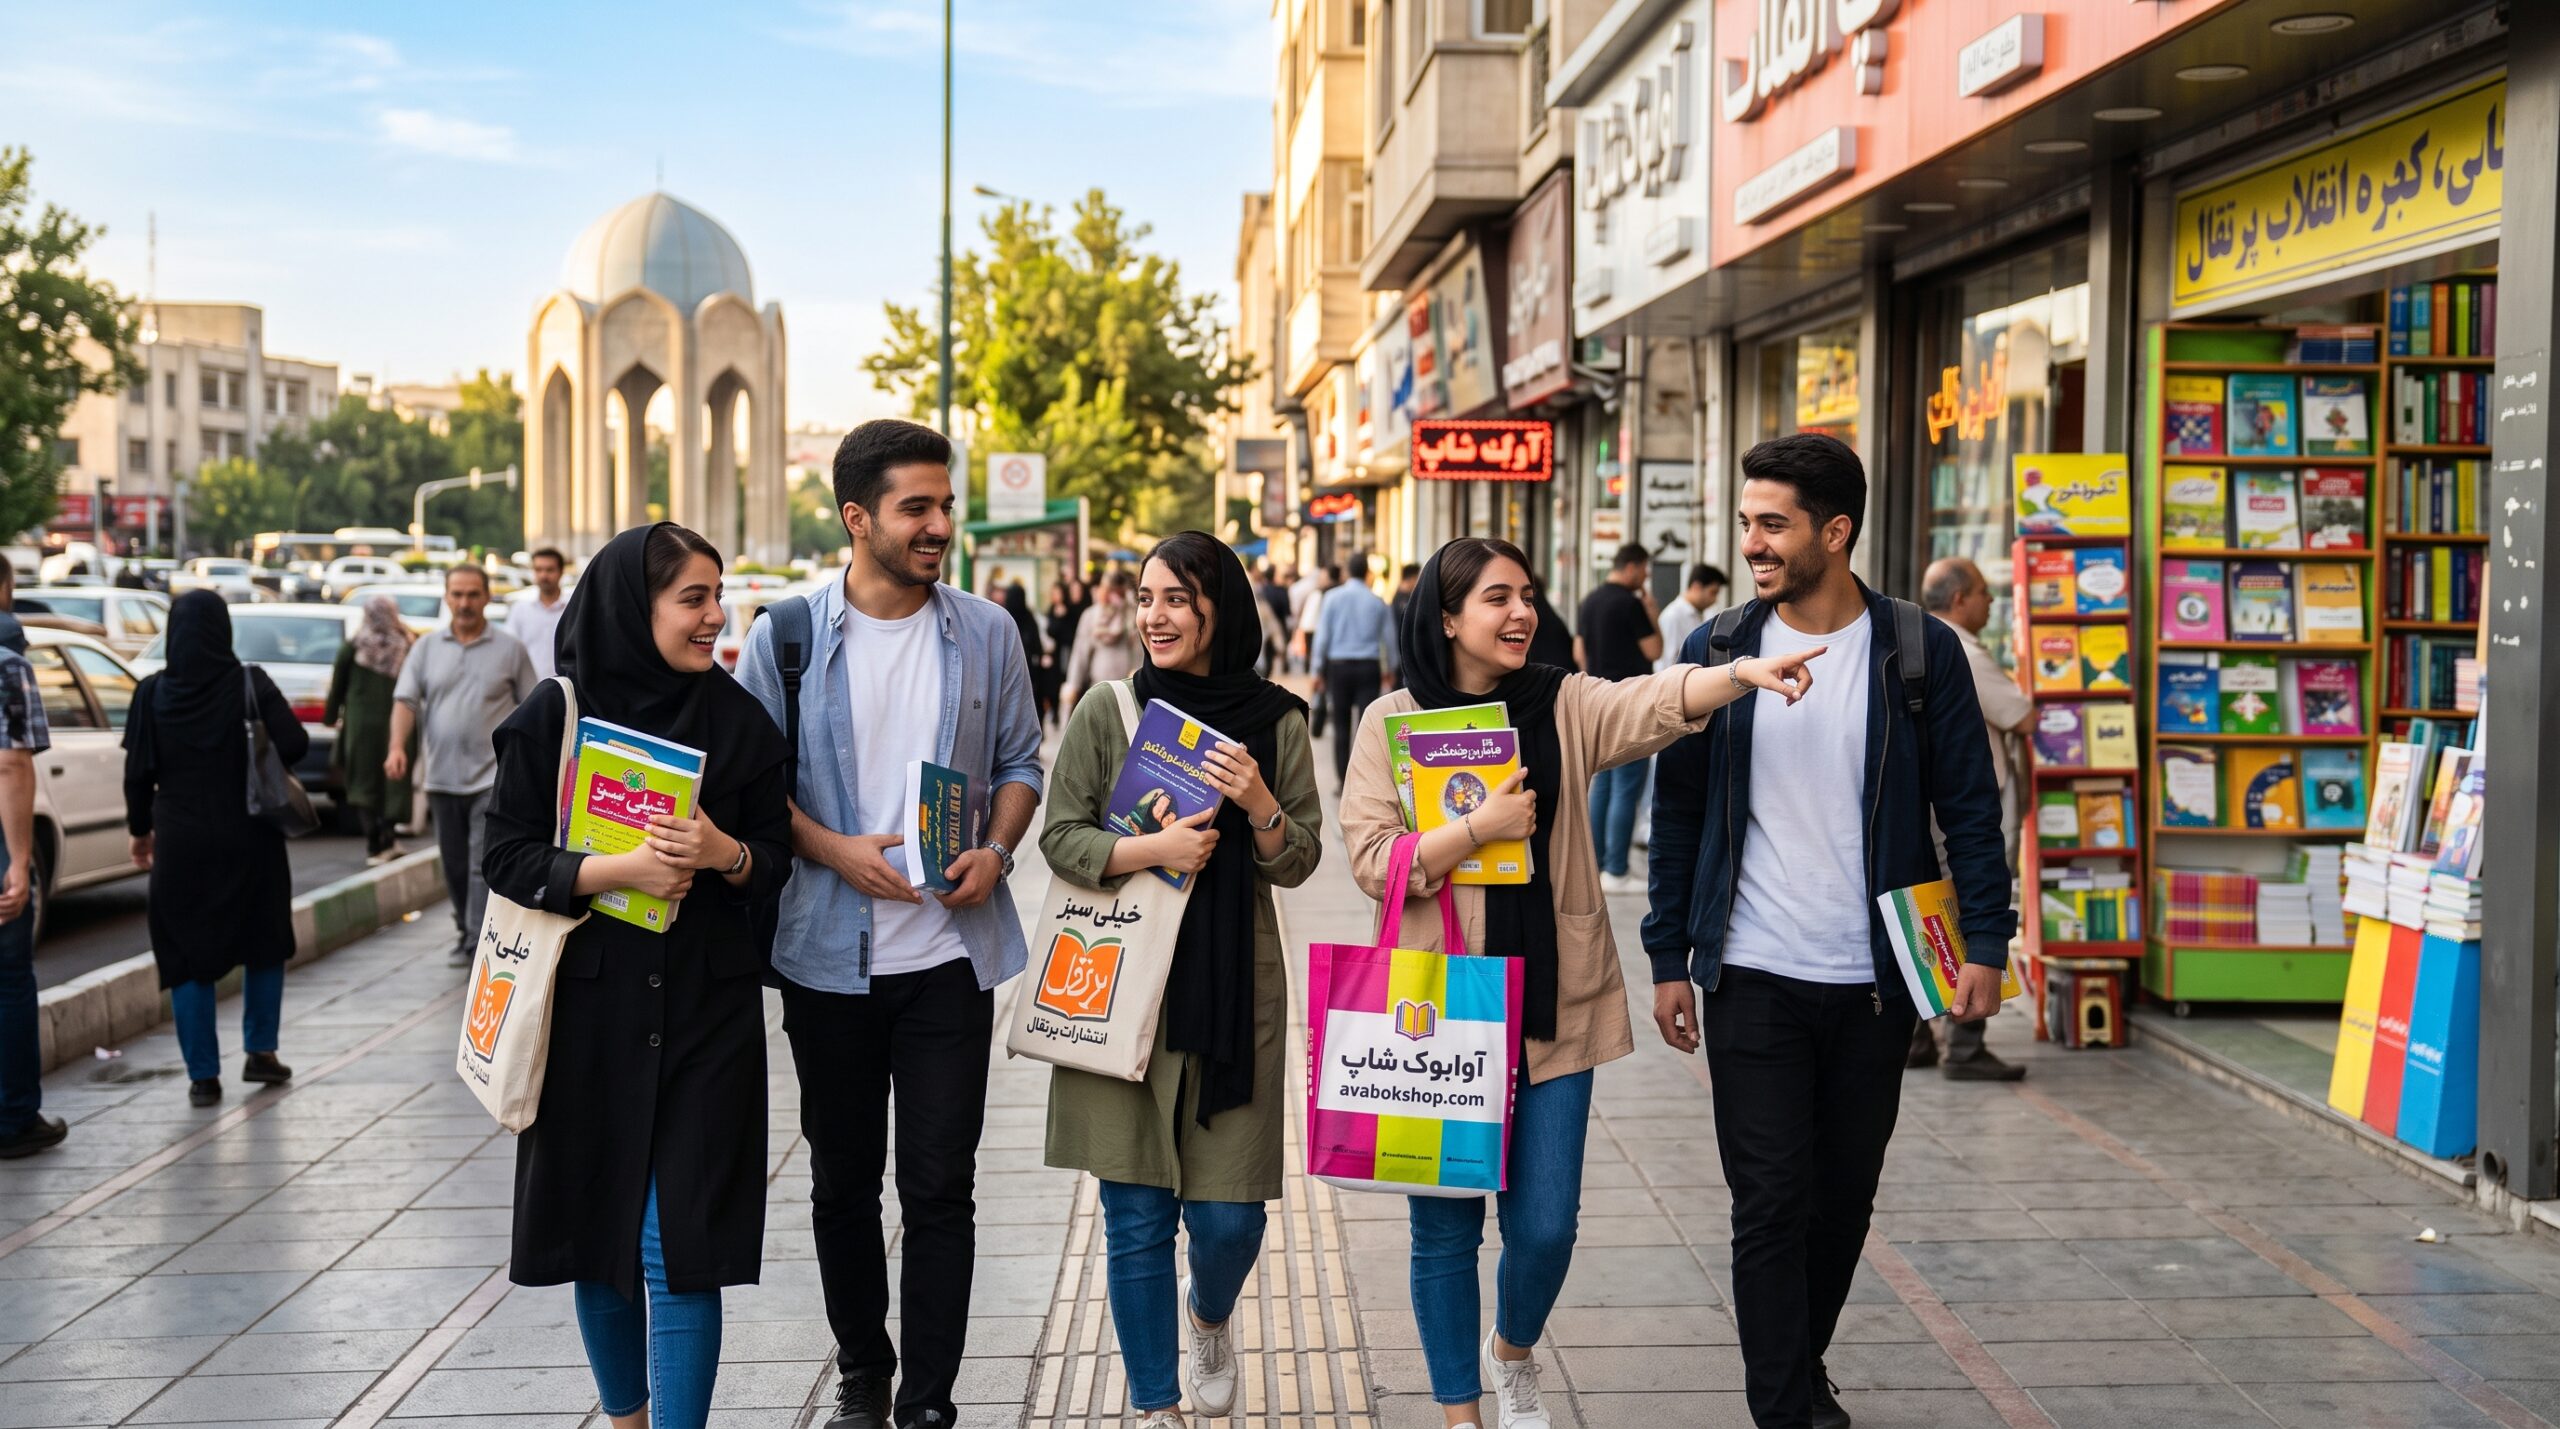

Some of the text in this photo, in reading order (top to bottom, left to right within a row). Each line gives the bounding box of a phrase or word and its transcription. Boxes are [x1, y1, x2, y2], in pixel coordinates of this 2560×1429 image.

[2265, 157, 2349, 256] انقلاب
[1056, 897, 1142, 929] خیلی سبز
[1060, 1024, 1108, 1046] انتشارات
[1341, 1047, 1398, 1079] شاپ
[1403, 1050, 1487, 1083] آوابوک
[1339, 1083, 1485, 1108] avabokshop.com
